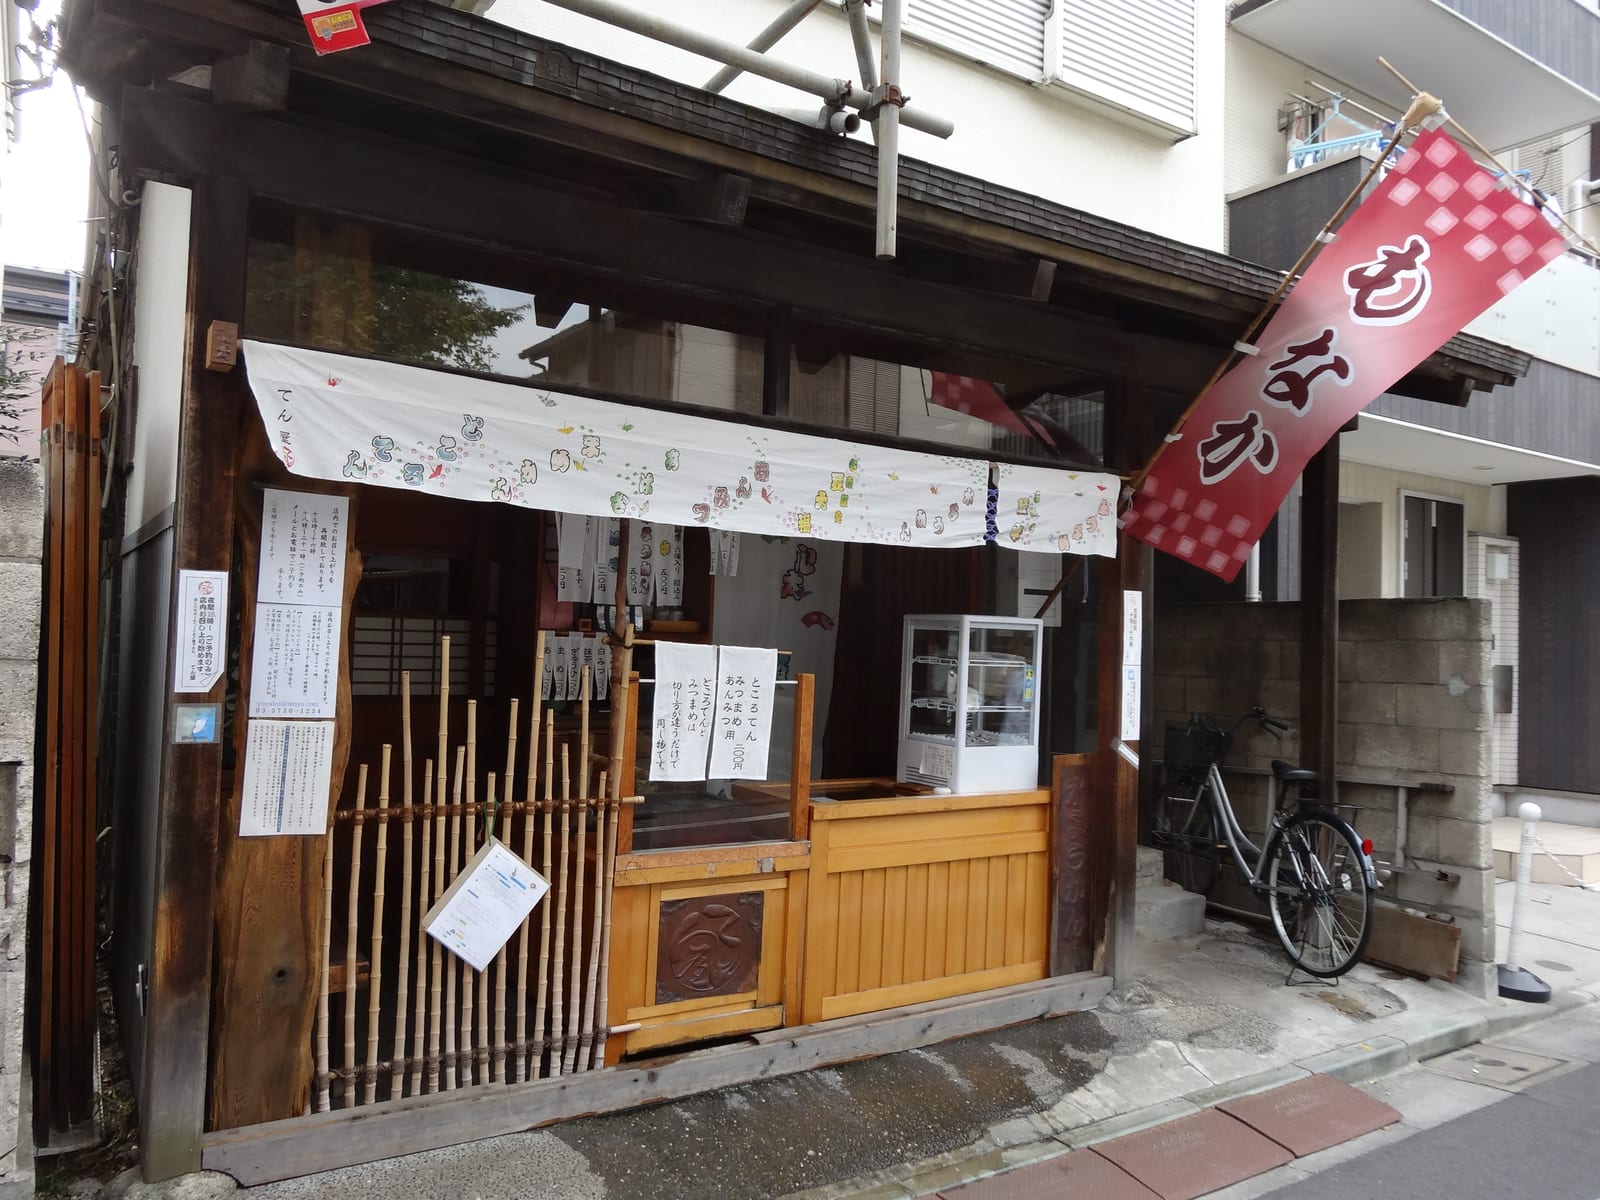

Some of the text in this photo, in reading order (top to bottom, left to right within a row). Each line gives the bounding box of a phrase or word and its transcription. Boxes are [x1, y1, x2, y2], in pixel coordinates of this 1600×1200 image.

[1197, 234, 1432, 486] もなか
[669, 681, 683, 769] 切り方が違うだけで
[687, 678, 699, 732] みつまめは
[698, 676, 712, 737] ところてんと
[721, 675, 735, 741] あんみつ 用
[731, 676, 746, 727] みつまめ
[745, 676, 760, 742] ところてん
